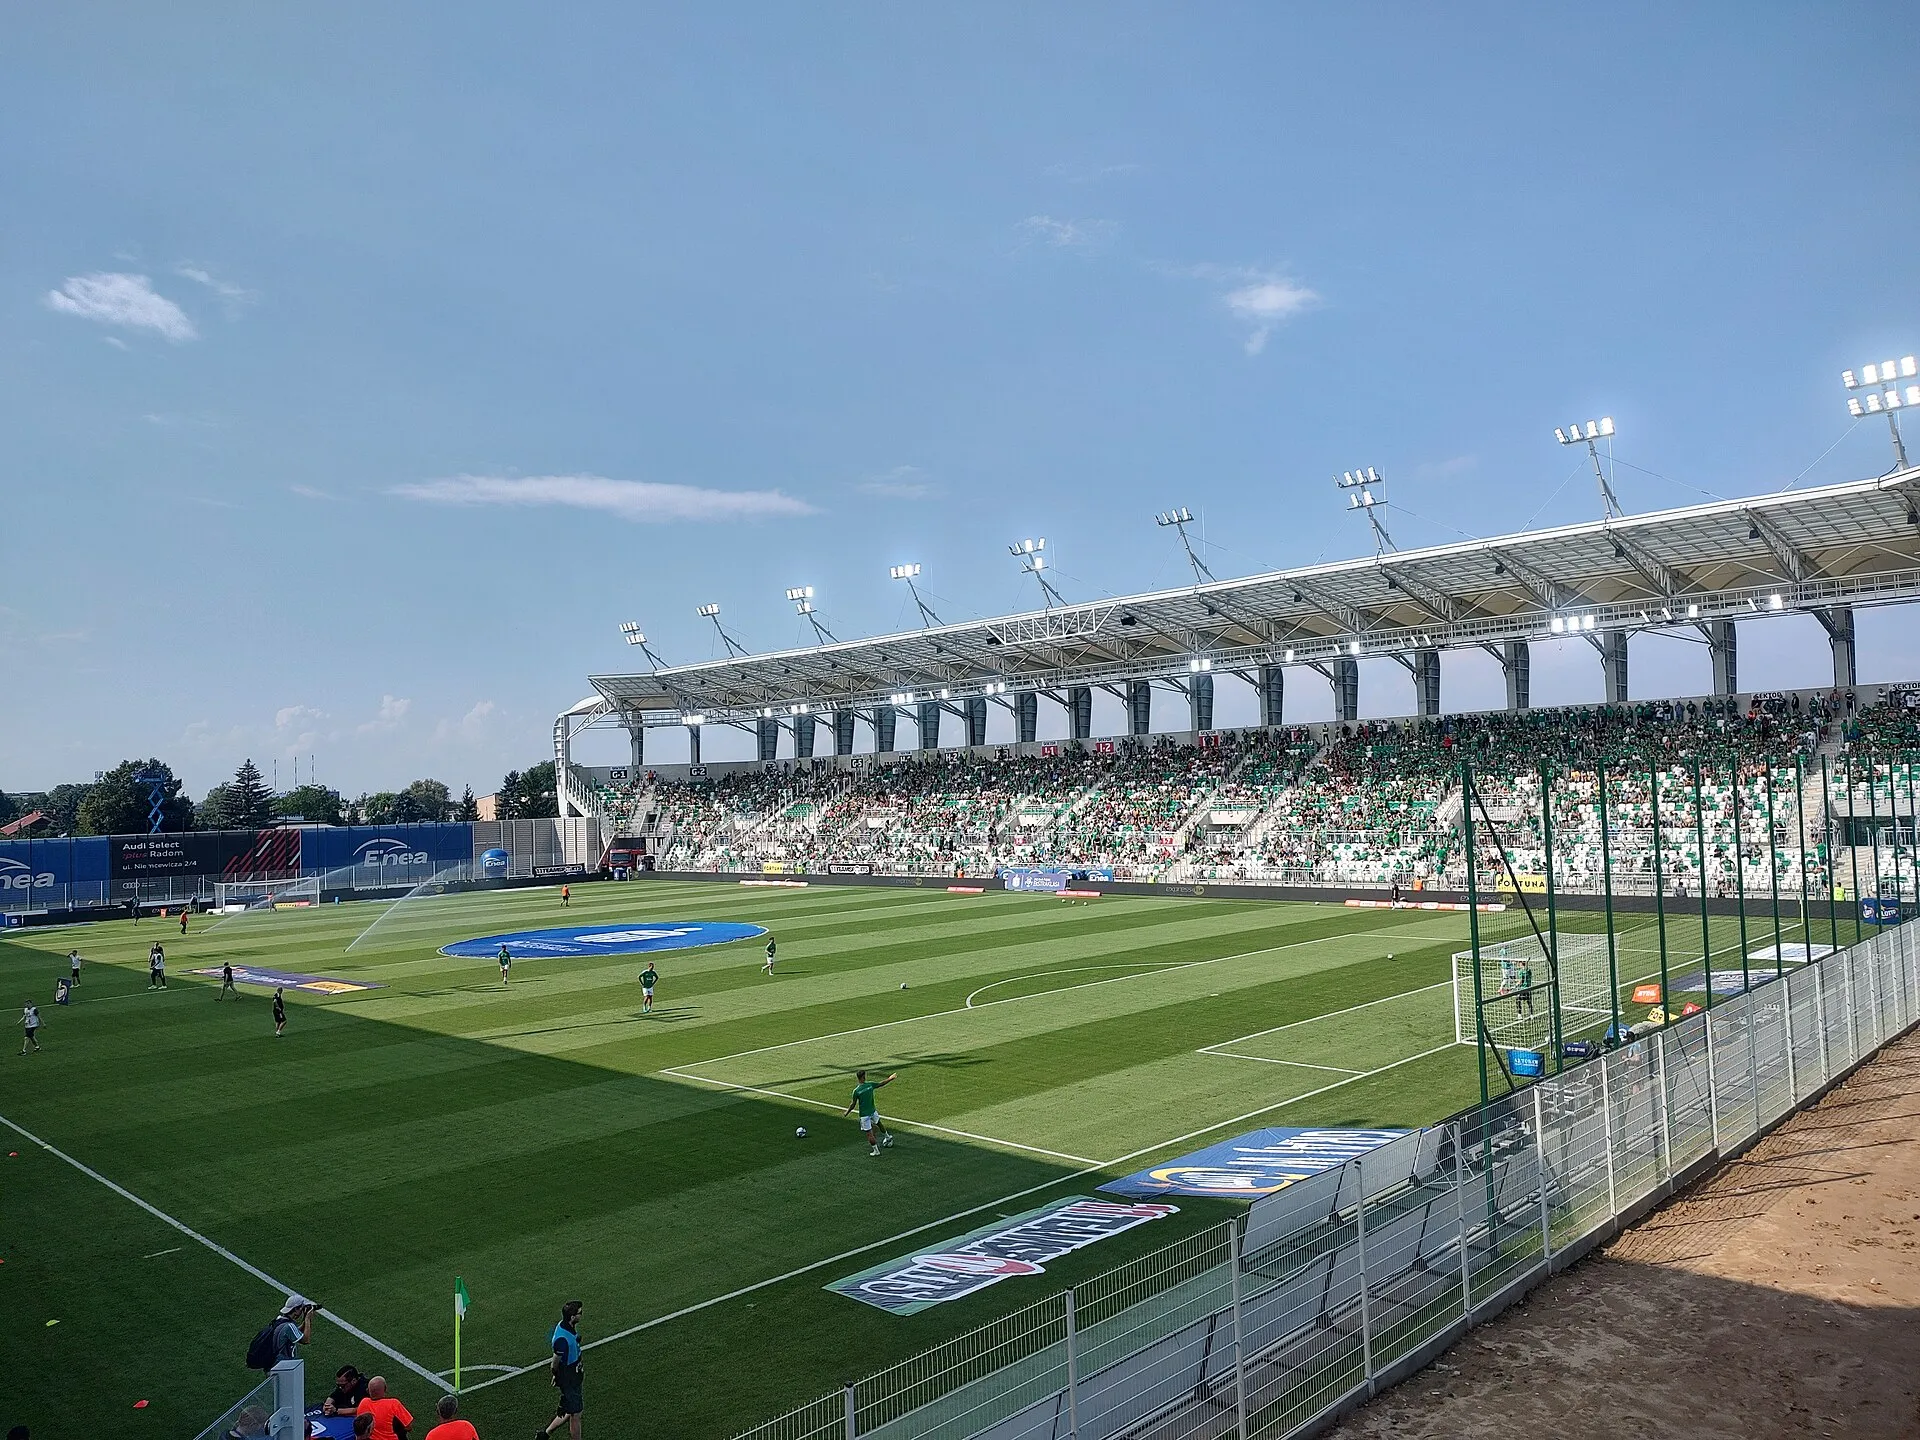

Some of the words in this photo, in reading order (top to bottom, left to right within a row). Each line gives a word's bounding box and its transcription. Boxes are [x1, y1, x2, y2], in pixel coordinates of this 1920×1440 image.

[122, 842, 146, 850] Audi
[149, 841, 180, 849] Select
[150, 850, 184, 858] Radom
[363, 850, 428, 867] Enea
[486, 860, 505, 868] Enea
[1088, 873, 1109, 882] Enea
